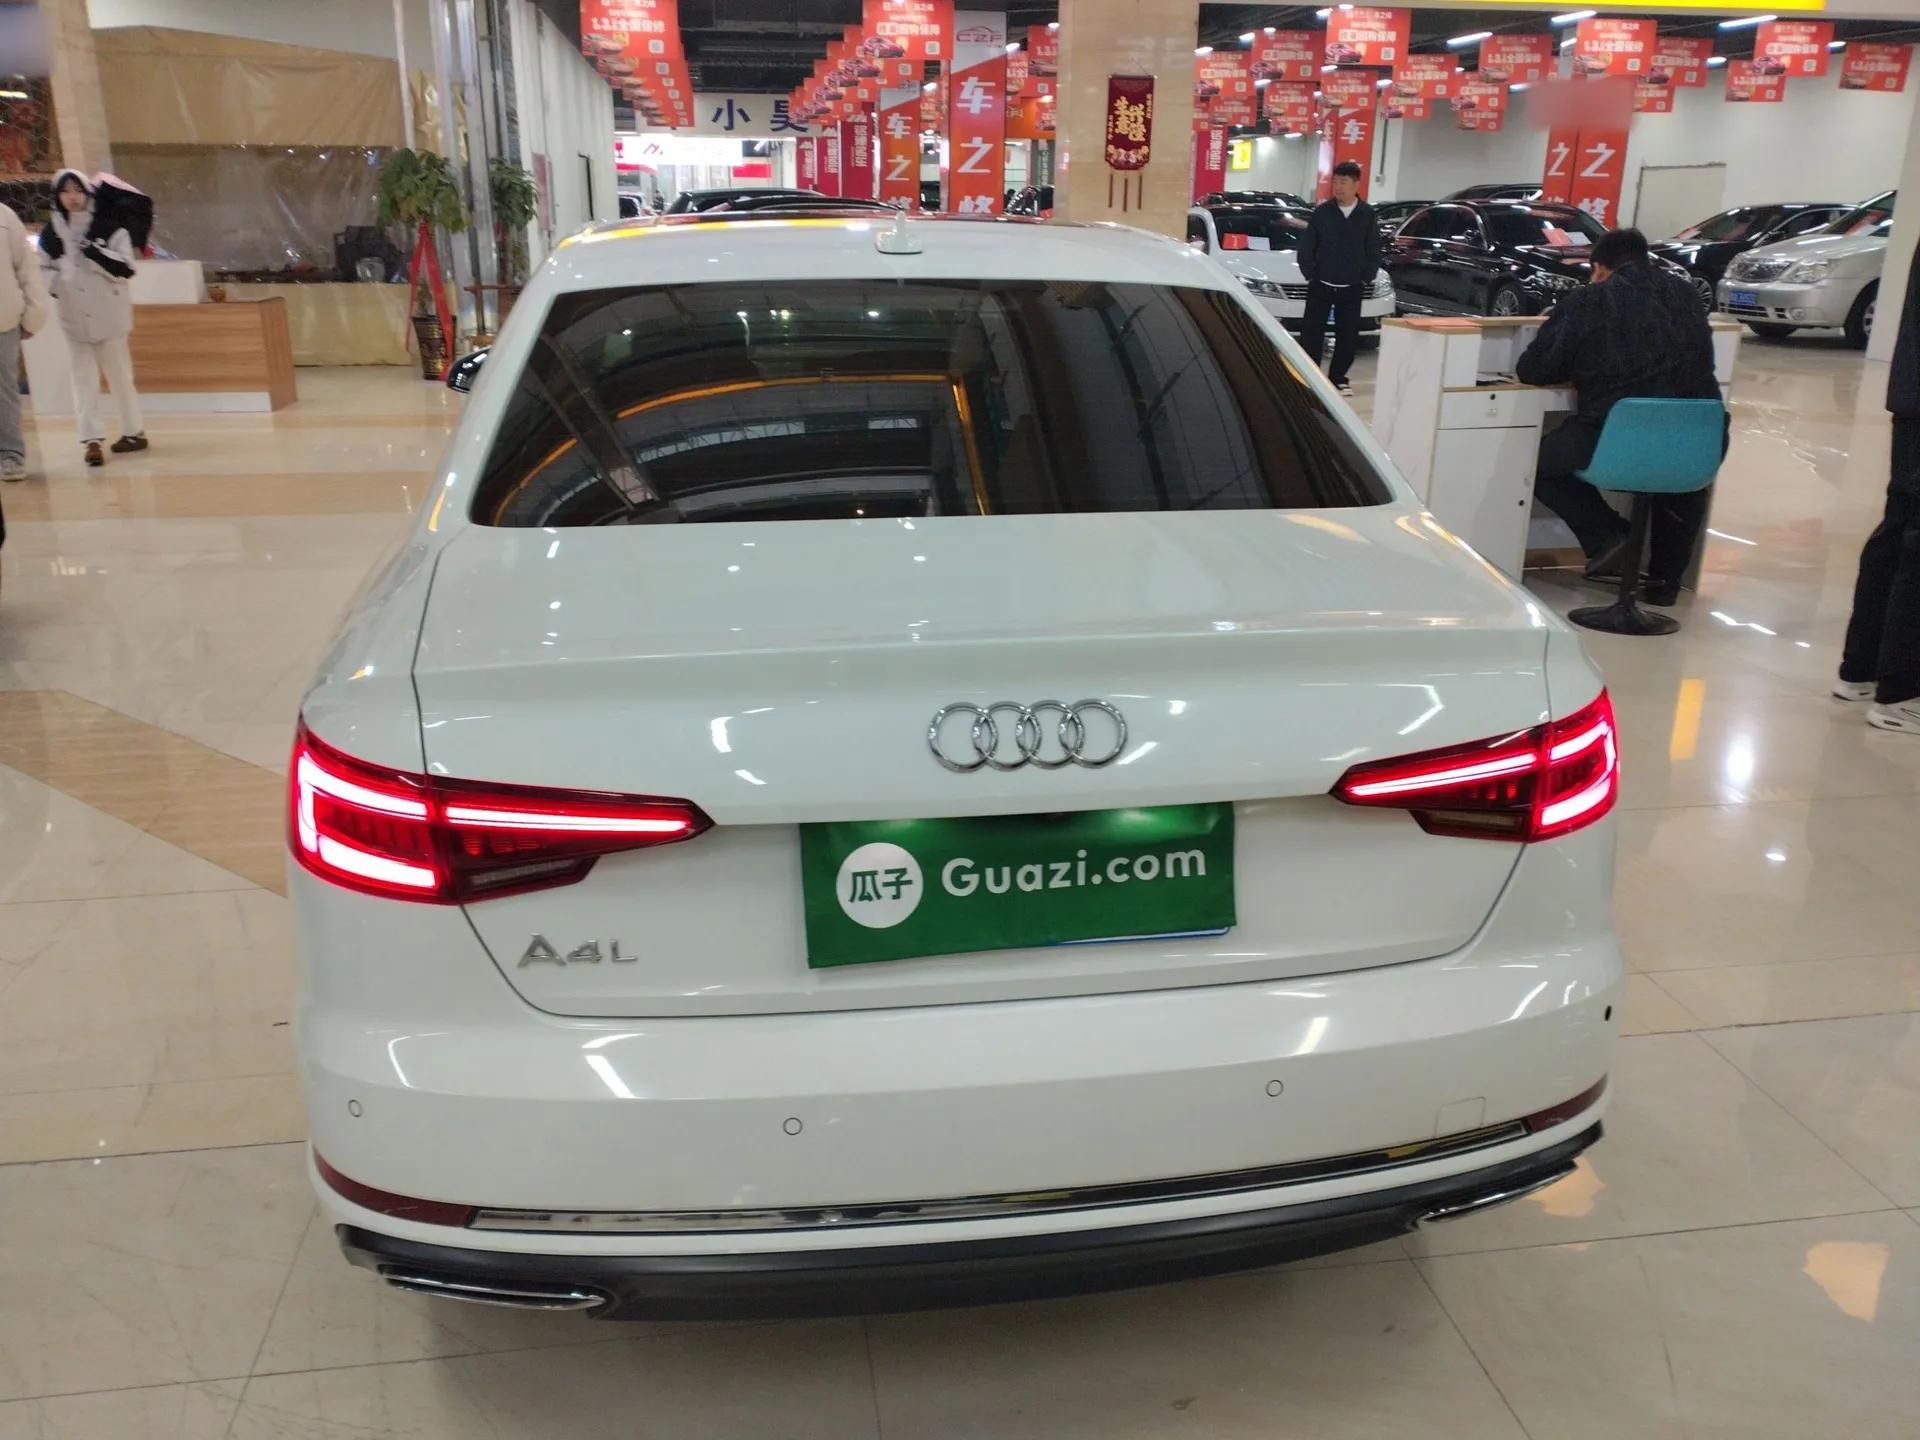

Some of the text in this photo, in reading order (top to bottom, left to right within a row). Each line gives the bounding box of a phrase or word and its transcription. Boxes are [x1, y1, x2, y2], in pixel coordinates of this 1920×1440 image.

[848, 868, 913, 903] 瓜子
[942, 849, 1207, 896] Guazi.com
[517, 931, 639, 968] A4L
